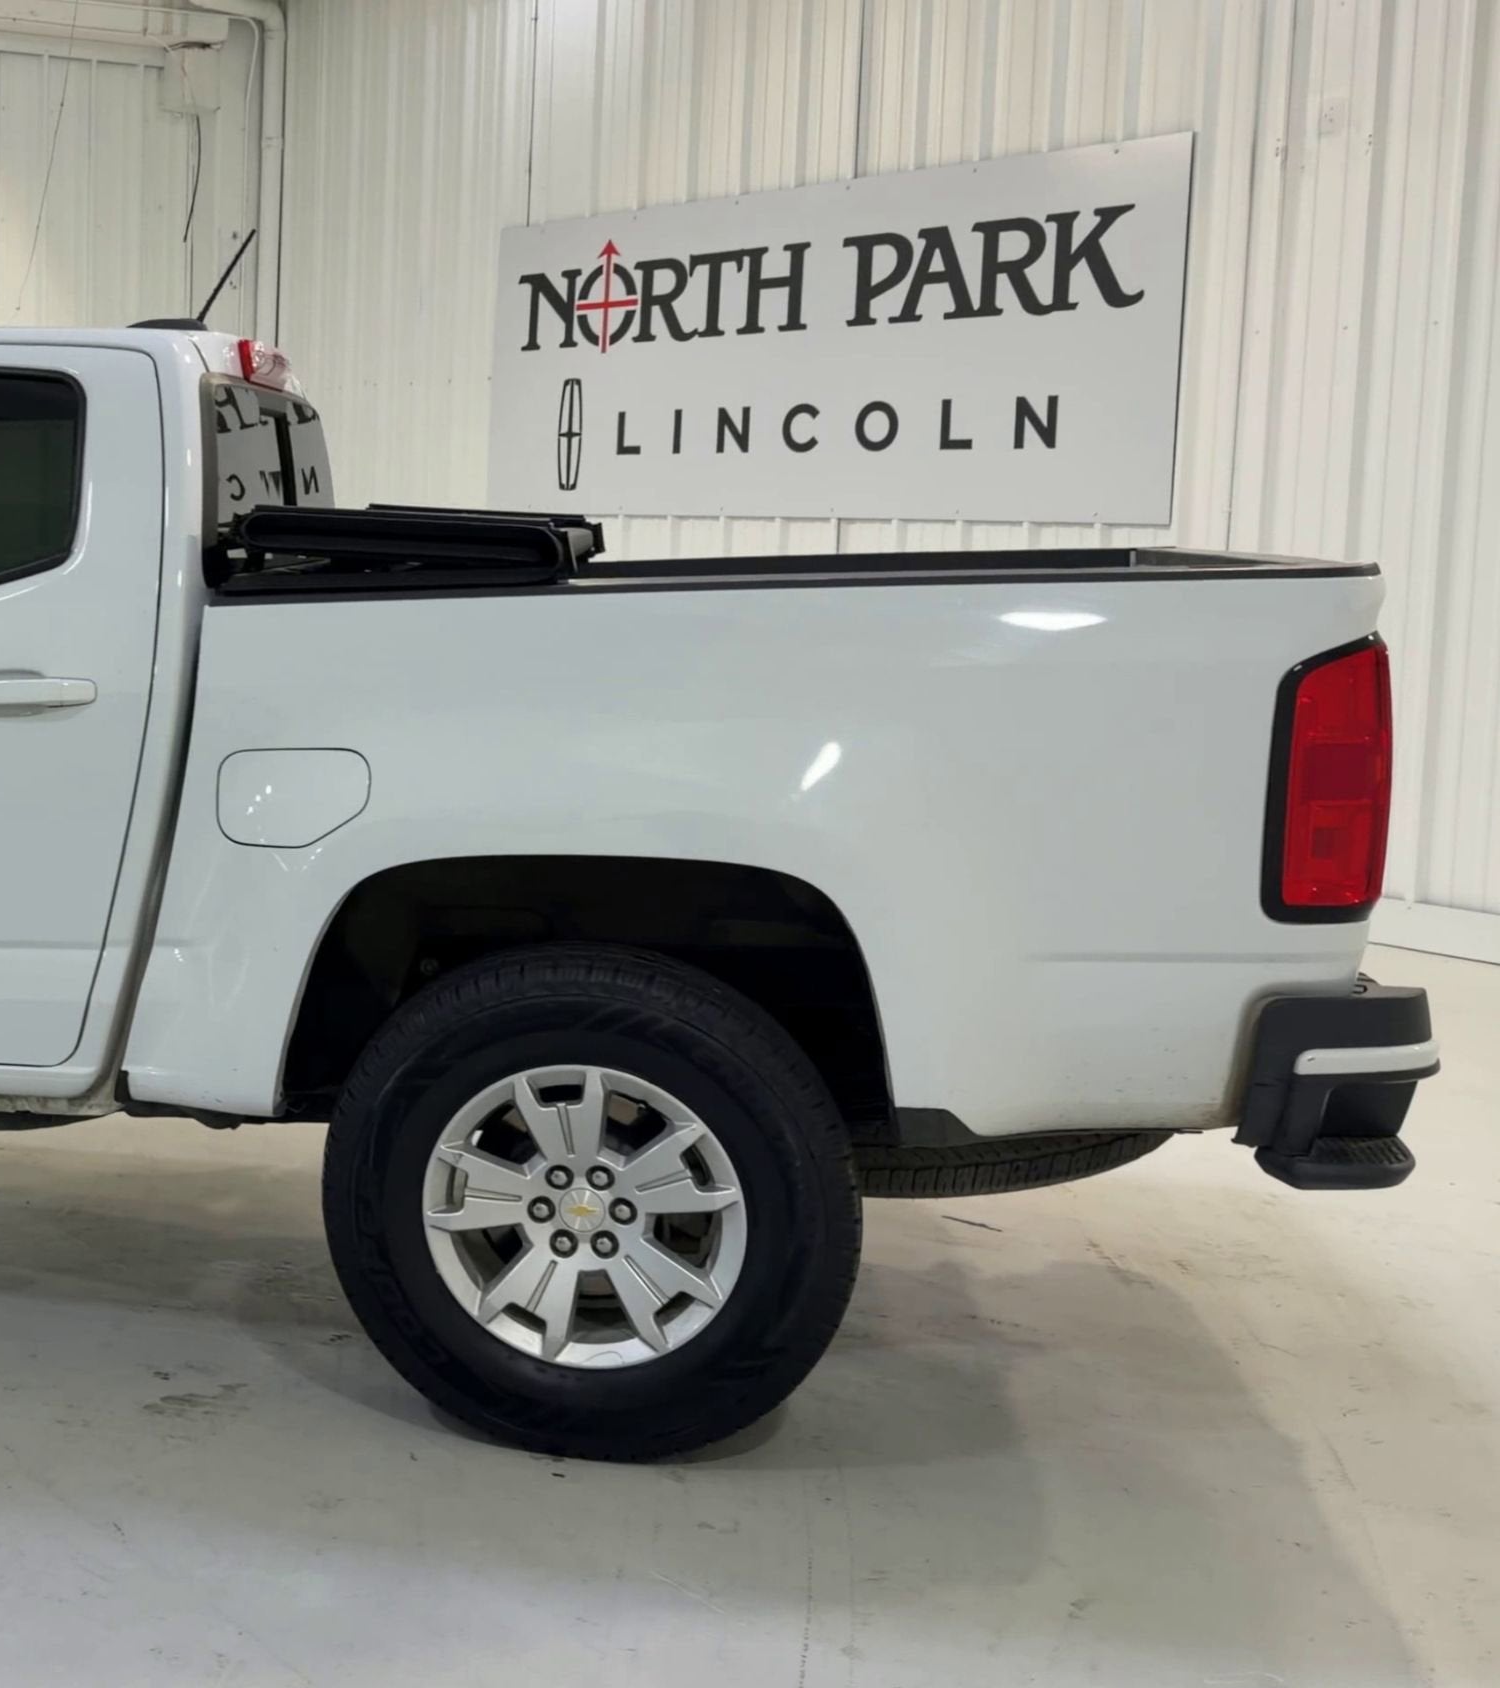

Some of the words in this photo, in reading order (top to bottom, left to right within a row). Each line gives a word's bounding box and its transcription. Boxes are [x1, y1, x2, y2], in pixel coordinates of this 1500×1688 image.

[518, 241, 812, 352] NORTH
[842, 203, 1145, 328] PARK
[616, 394, 1059, 456] LINCOLN
